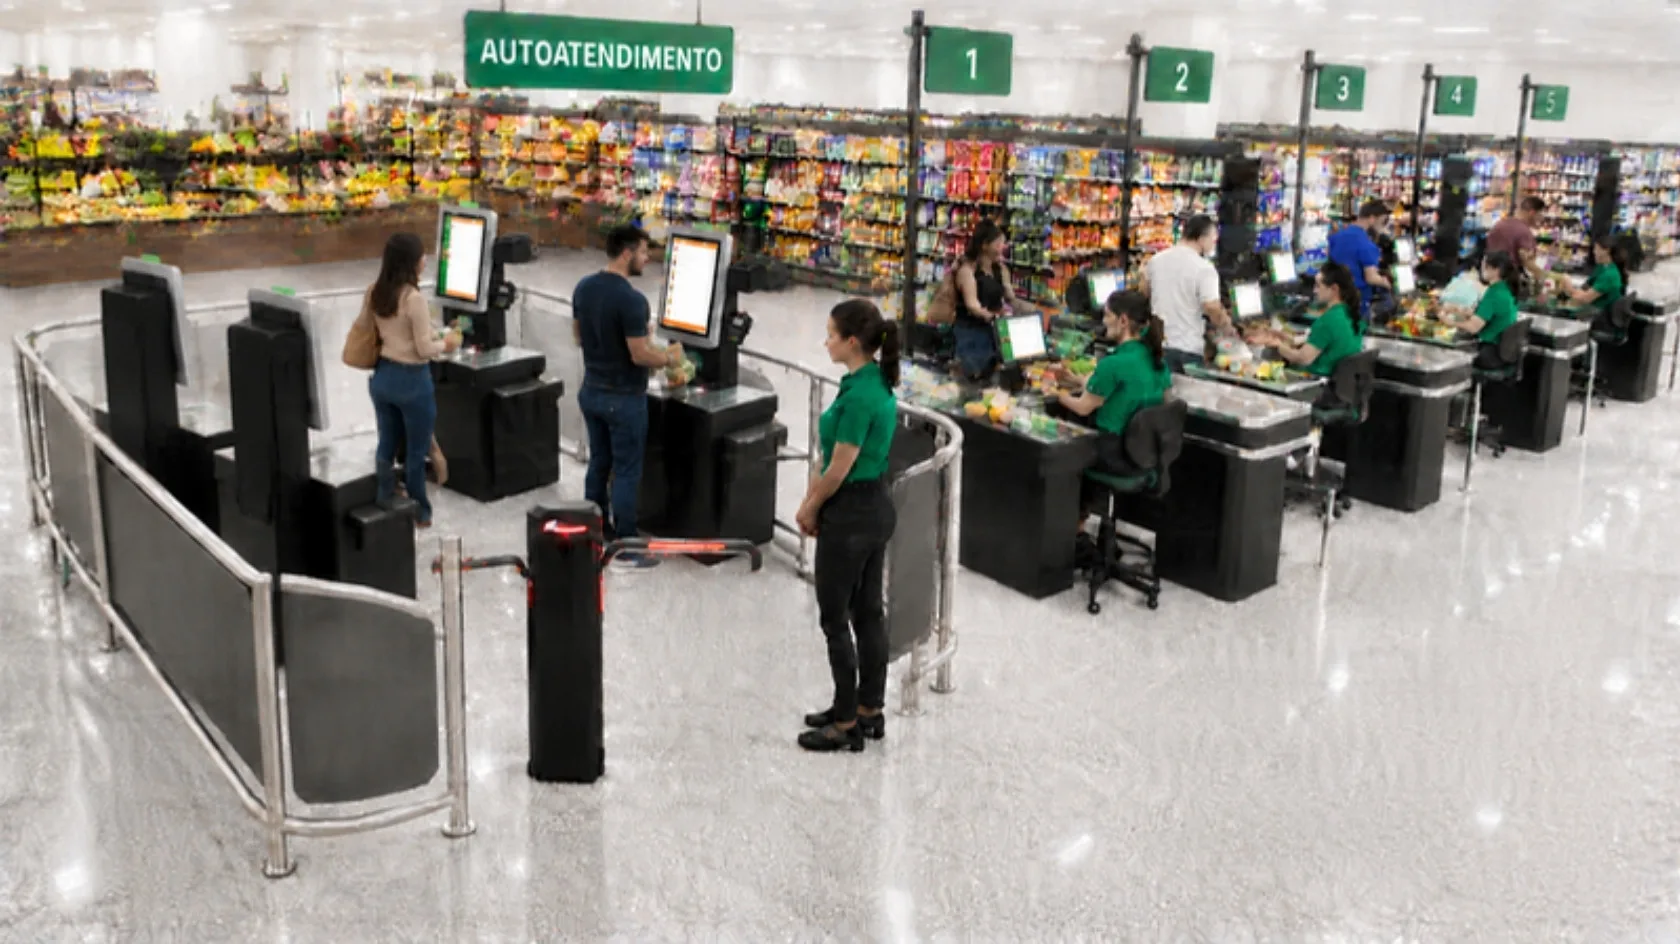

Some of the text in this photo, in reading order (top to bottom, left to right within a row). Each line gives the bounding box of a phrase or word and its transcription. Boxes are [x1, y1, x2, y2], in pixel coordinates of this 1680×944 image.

[481, 38, 722, 72] AUTOATENDIMENTO
[966, 48, 977, 79] 1
[1175, 62, 1188, 91] 2
[1337, 76, 1349, 101] 3
[1451, 84, 1462, 103] 4
[1545, 92, 1556, 113] 5
